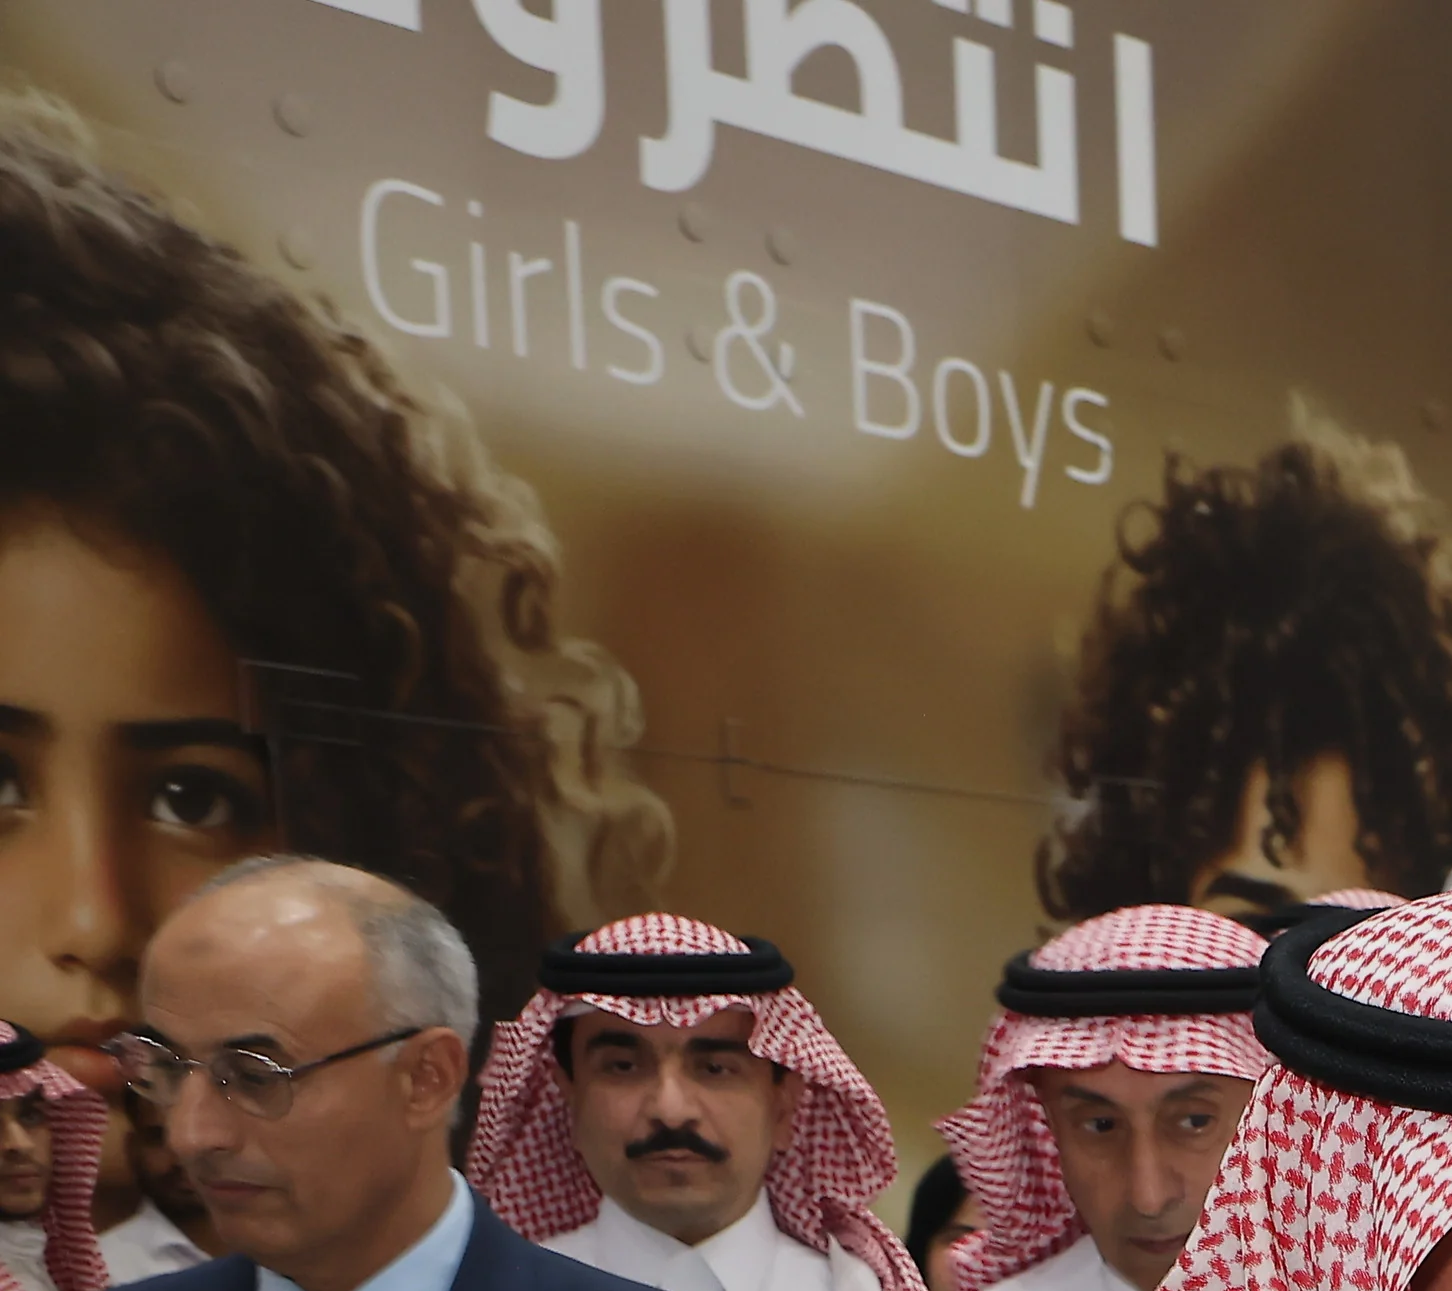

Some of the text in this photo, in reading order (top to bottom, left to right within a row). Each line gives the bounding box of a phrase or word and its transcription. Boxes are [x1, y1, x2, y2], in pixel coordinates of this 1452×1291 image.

[360, 178, 1113, 510] Girls & Boys
